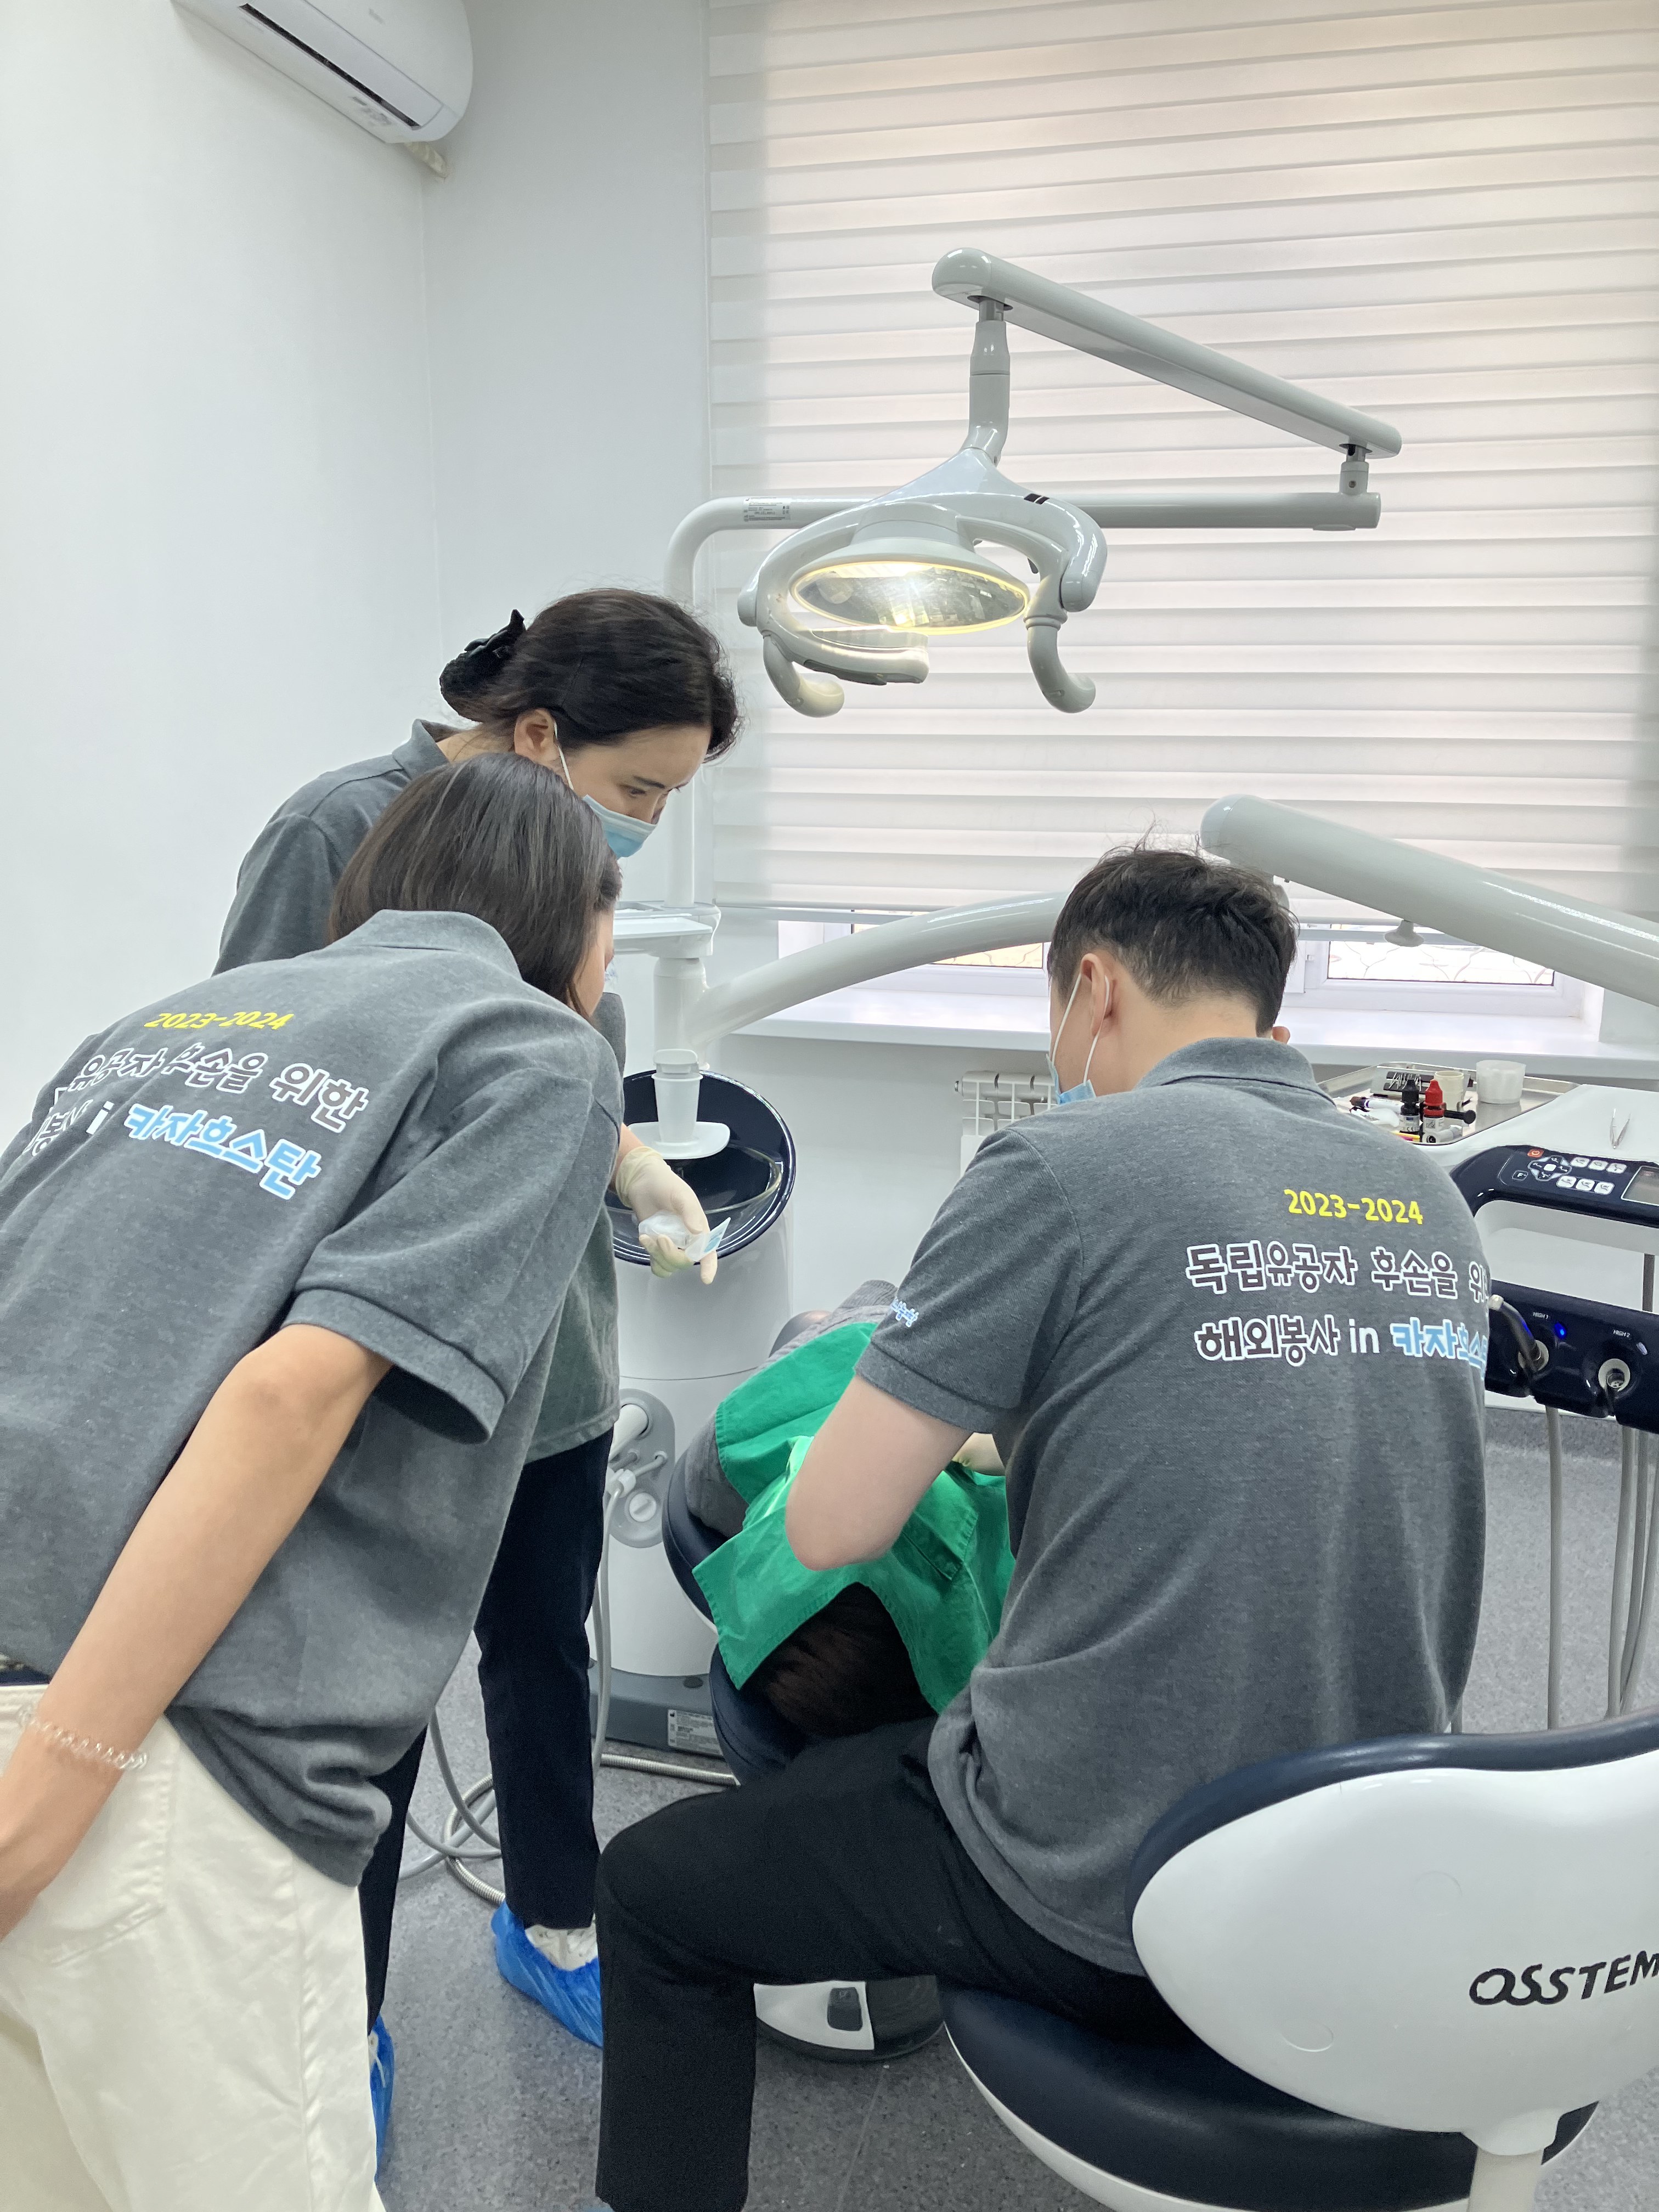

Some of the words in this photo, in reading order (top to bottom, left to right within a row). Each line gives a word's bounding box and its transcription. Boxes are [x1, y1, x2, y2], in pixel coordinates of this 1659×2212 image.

[143, 1011, 295, 1030] 2023-2024
[268, 1063, 369, 1133] 위한
[1284, 1189, 1424, 1224] 2023-2024
[1186, 1240, 1358, 1295] 독립유공자
[1371, 1246, 1458, 1300] 후손을
[1469, 1261, 1489, 1305] 위
[1194, 1314, 1340, 1367] 해외봉사
[1348, 1319, 1380, 1353] in
[1469, 1950, 1659, 2006] OSSTEM
